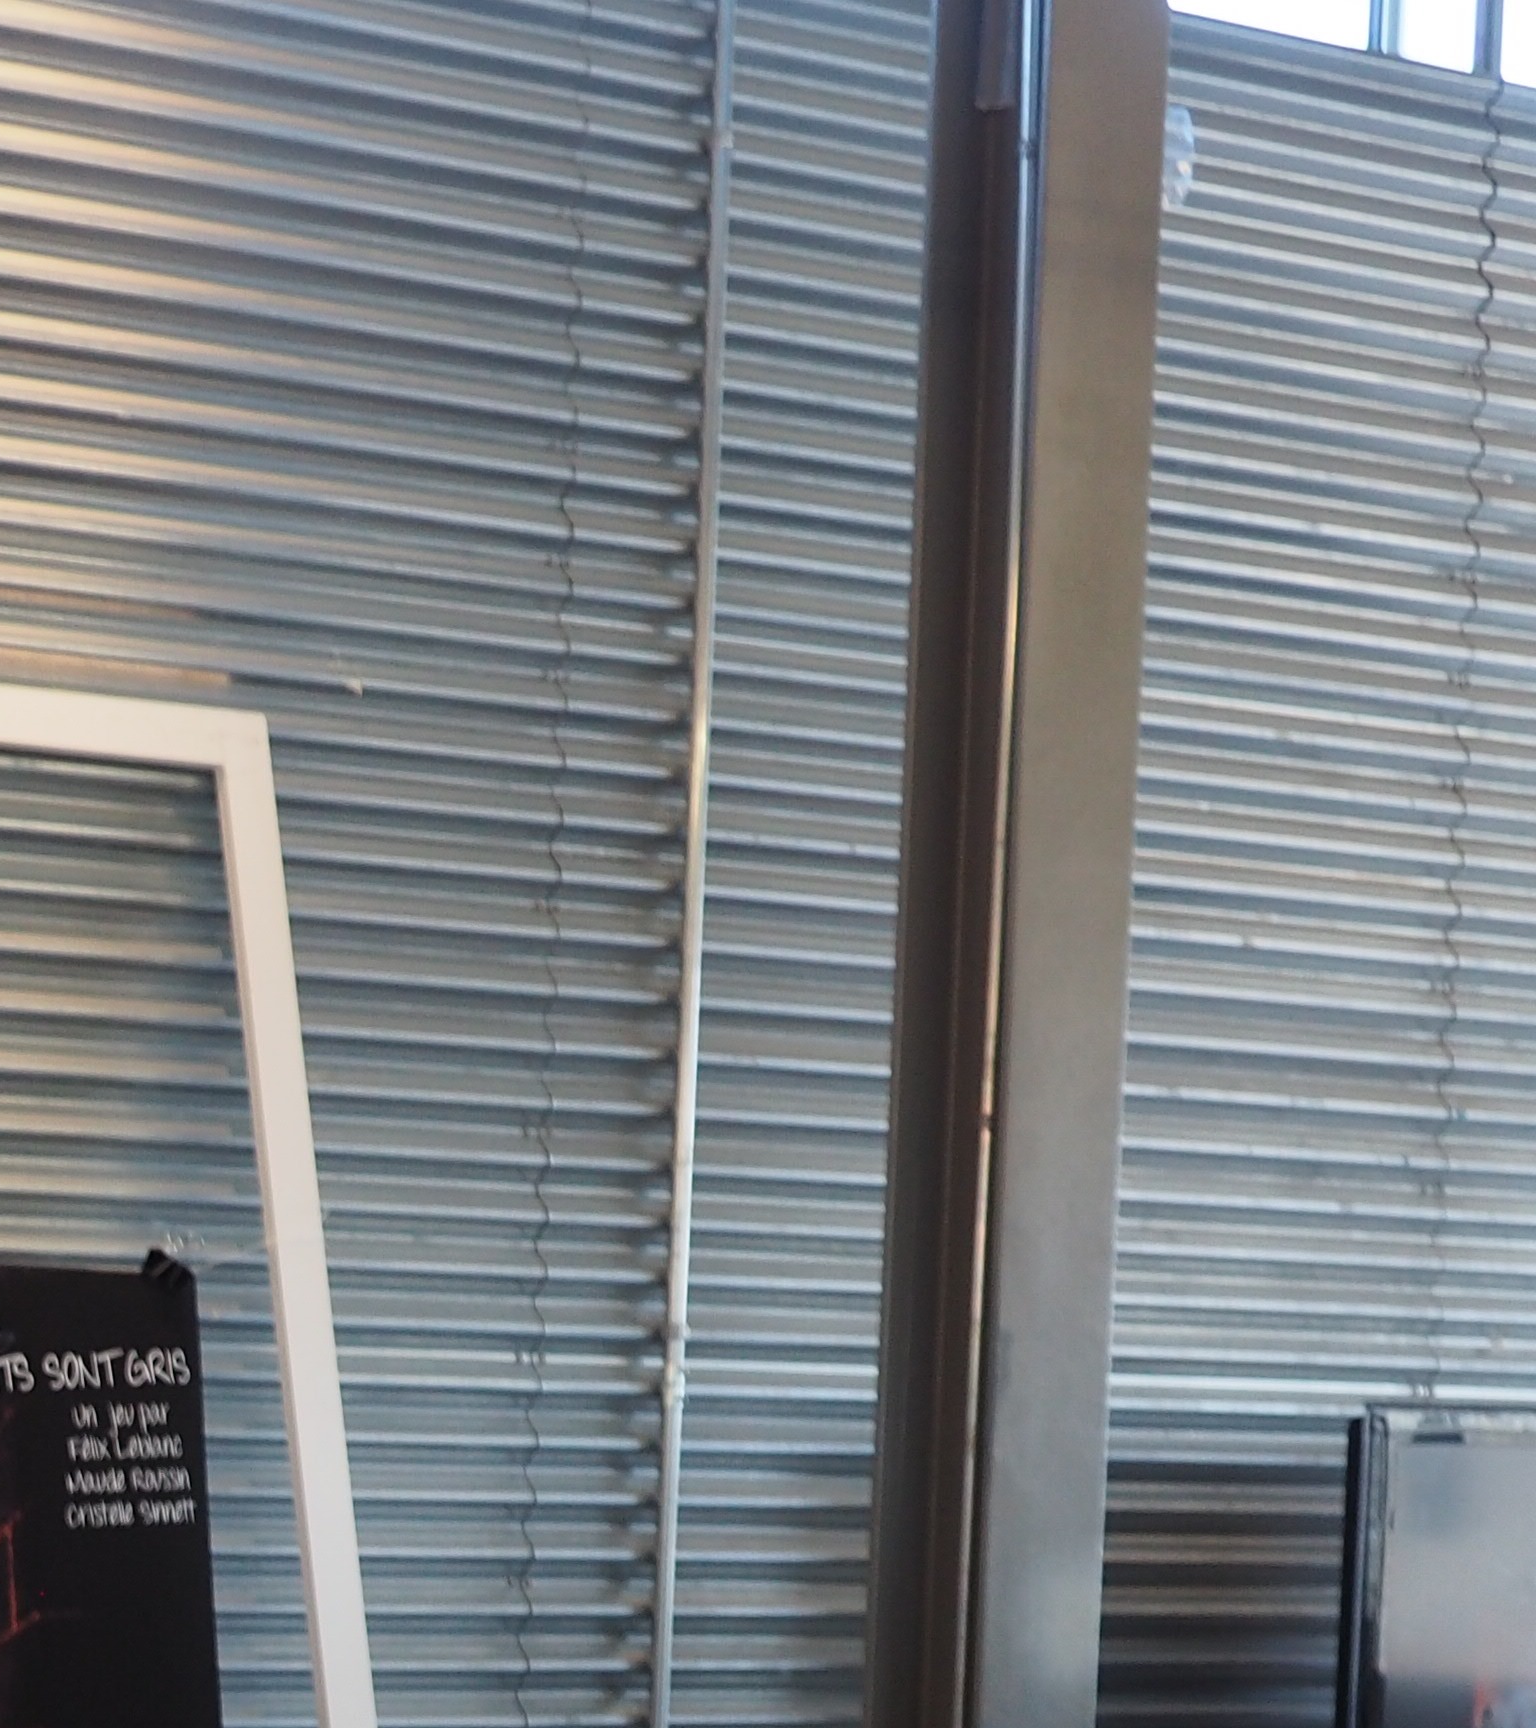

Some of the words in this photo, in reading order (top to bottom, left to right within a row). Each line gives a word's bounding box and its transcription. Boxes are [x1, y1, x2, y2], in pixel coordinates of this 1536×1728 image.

[42, 1346, 125, 1392] SONT
[127, 1346, 192, 1389] GRIS
[136, 1401, 170, 1434] par
